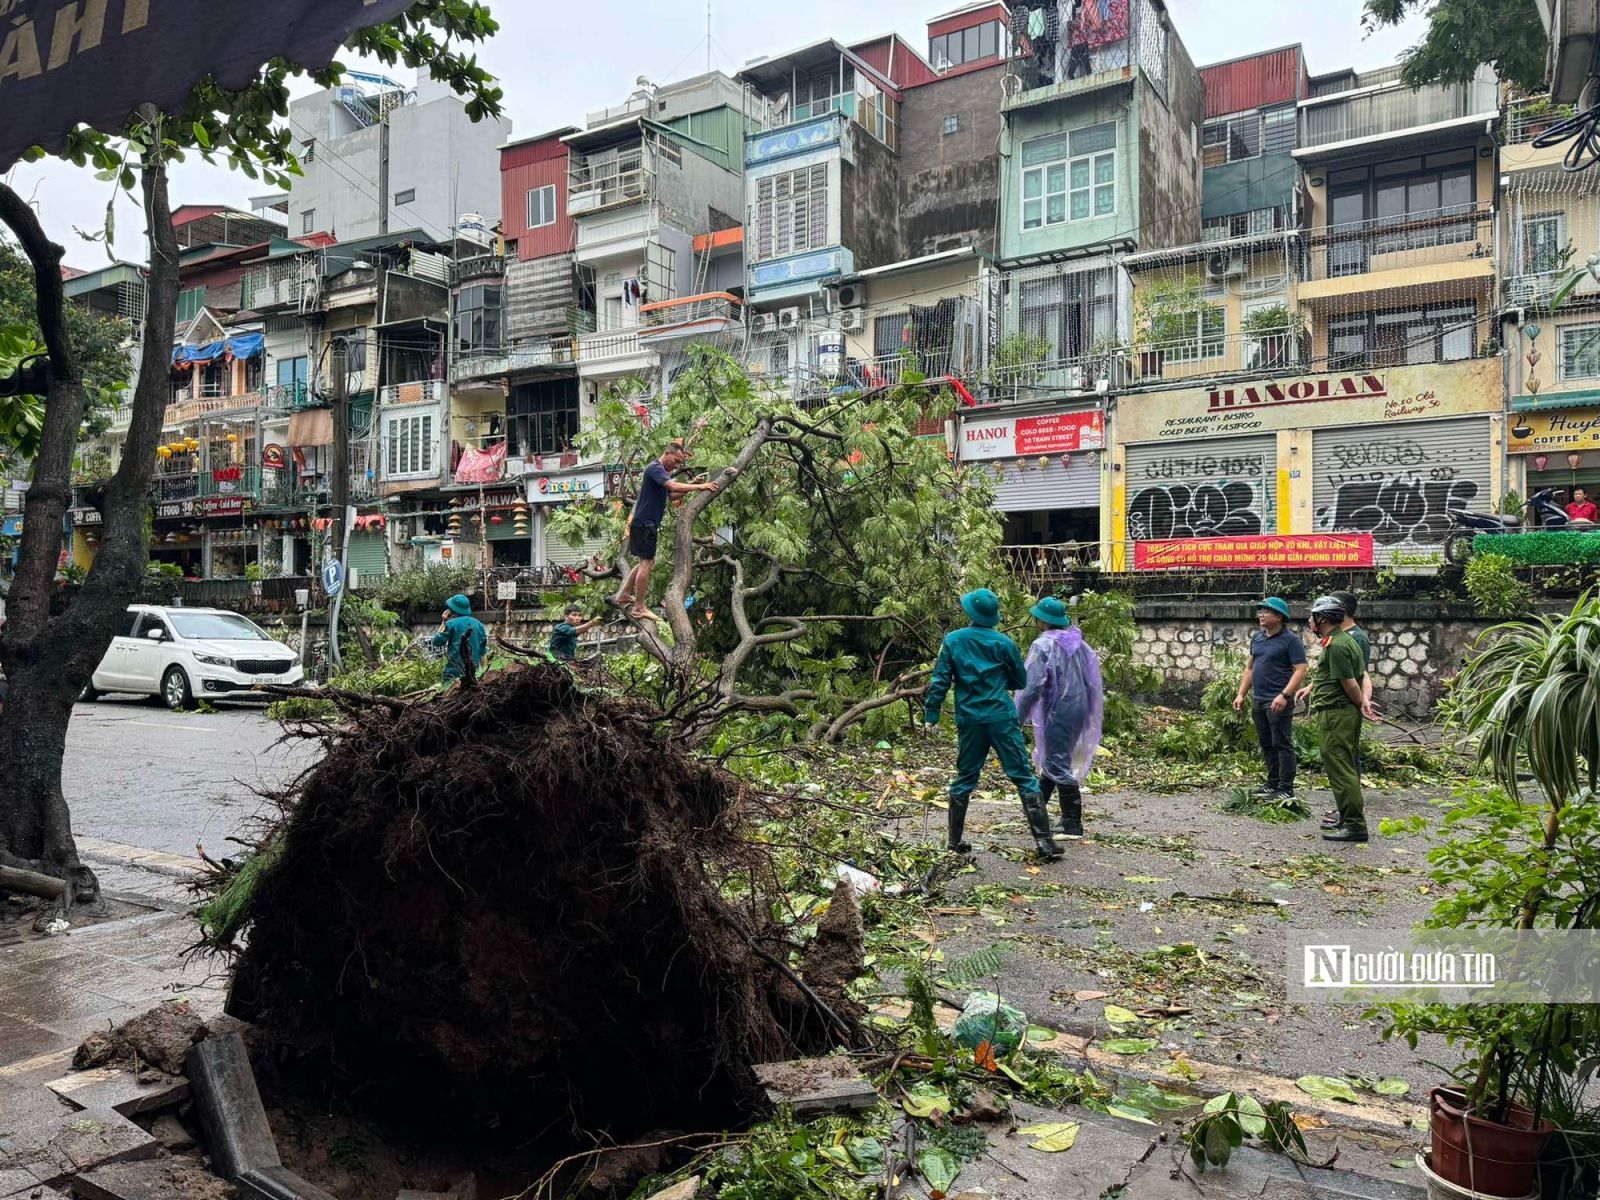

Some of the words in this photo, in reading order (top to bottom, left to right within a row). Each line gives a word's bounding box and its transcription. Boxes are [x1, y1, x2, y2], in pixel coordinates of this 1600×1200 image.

[1210, 374, 1385, 407] HANOIAN
[1415, 390, 1435, 402] Old
[1223, 412, 1255, 422] BISTRO
[1384, 406, 1426, 418] Railway
[1036, 417, 1060, 426] COFFEE
[966, 426, 1008, 442] HANOI
[1020, 428, 1038, 436] COLD
[1038, 426, 1055, 435] BEER
[1057, 424, 1077, 433] FOOD
[1159, 428, 1184, 437] COLD
[1184, 425, 1208, 435] BEER
[1216, 421, 1262, 432] FASTFOOD
[1023, 436, 1031, 444] 10
[1031, 435, 1050, 443] TRAIN
[1051, 432, 1074, 442] STREET
[1533, 434, 1579, 445] COFFEE
[164, 505, 180, 516] FOOD
[181, 501, 194, 512] 30
[73, 511, 83, 521] 30
[1215, 542, 1234, 551] THAM
[1236, 541, 1248, 550] GIA
[1249, 541, 1266, 550] GIAO
[328, 565, 337, 584] P
